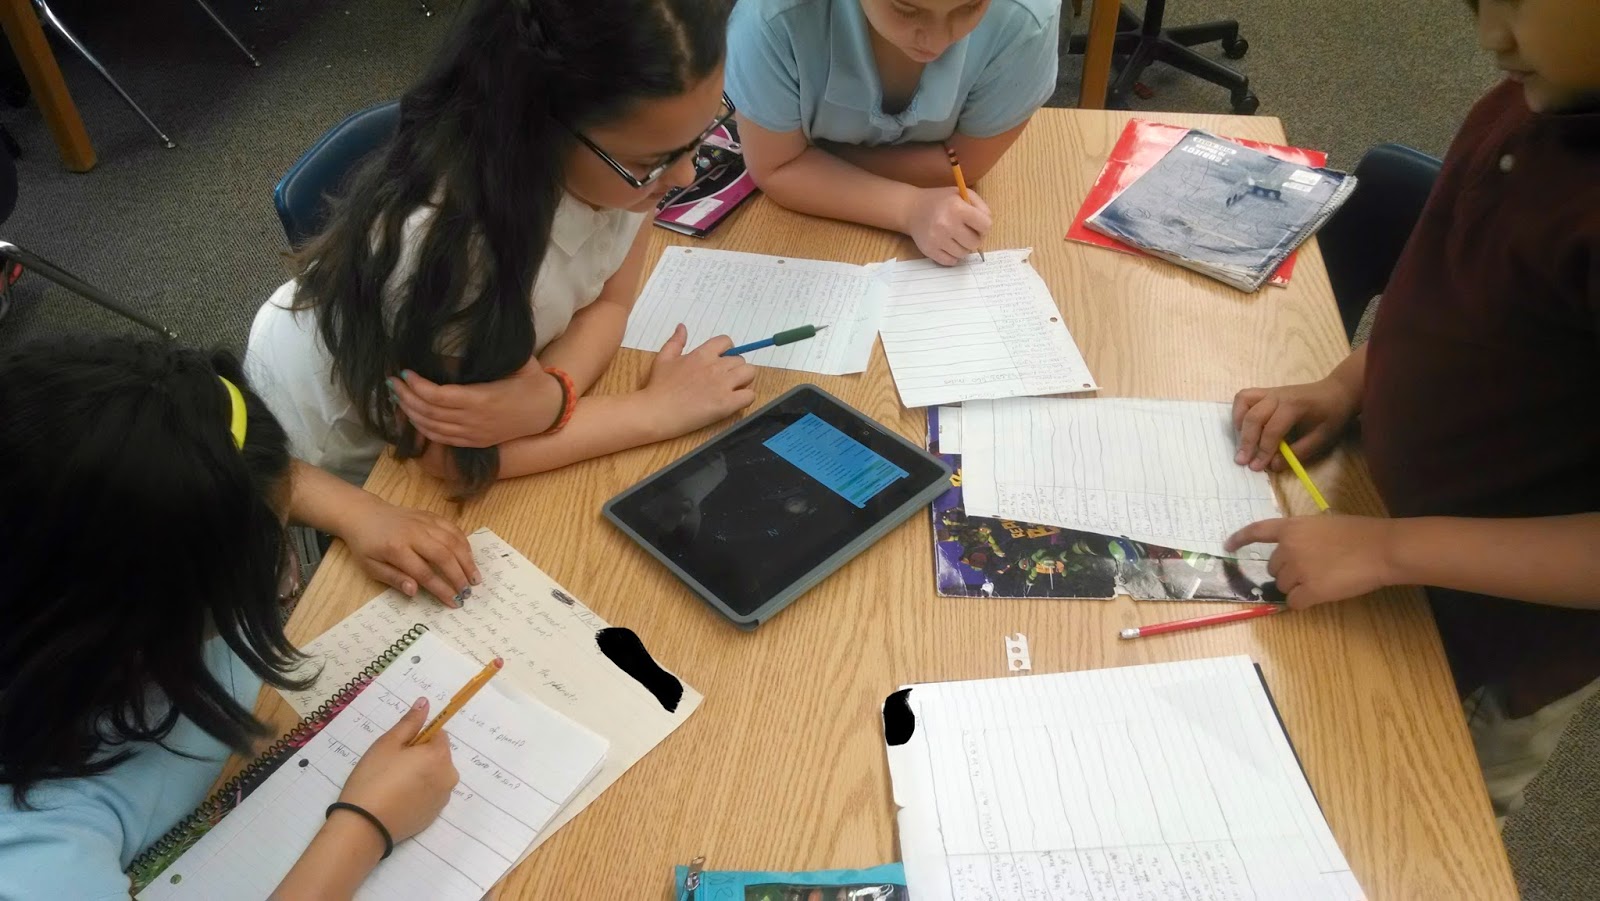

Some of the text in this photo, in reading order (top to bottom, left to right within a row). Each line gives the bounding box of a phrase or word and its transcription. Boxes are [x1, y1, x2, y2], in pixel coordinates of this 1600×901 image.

[1181, 145, 1222, 162] SUBJECT
[360, 720, 375, 734] How
[488, 726, 502, 735] of
[334, 744, 350, 758] How
